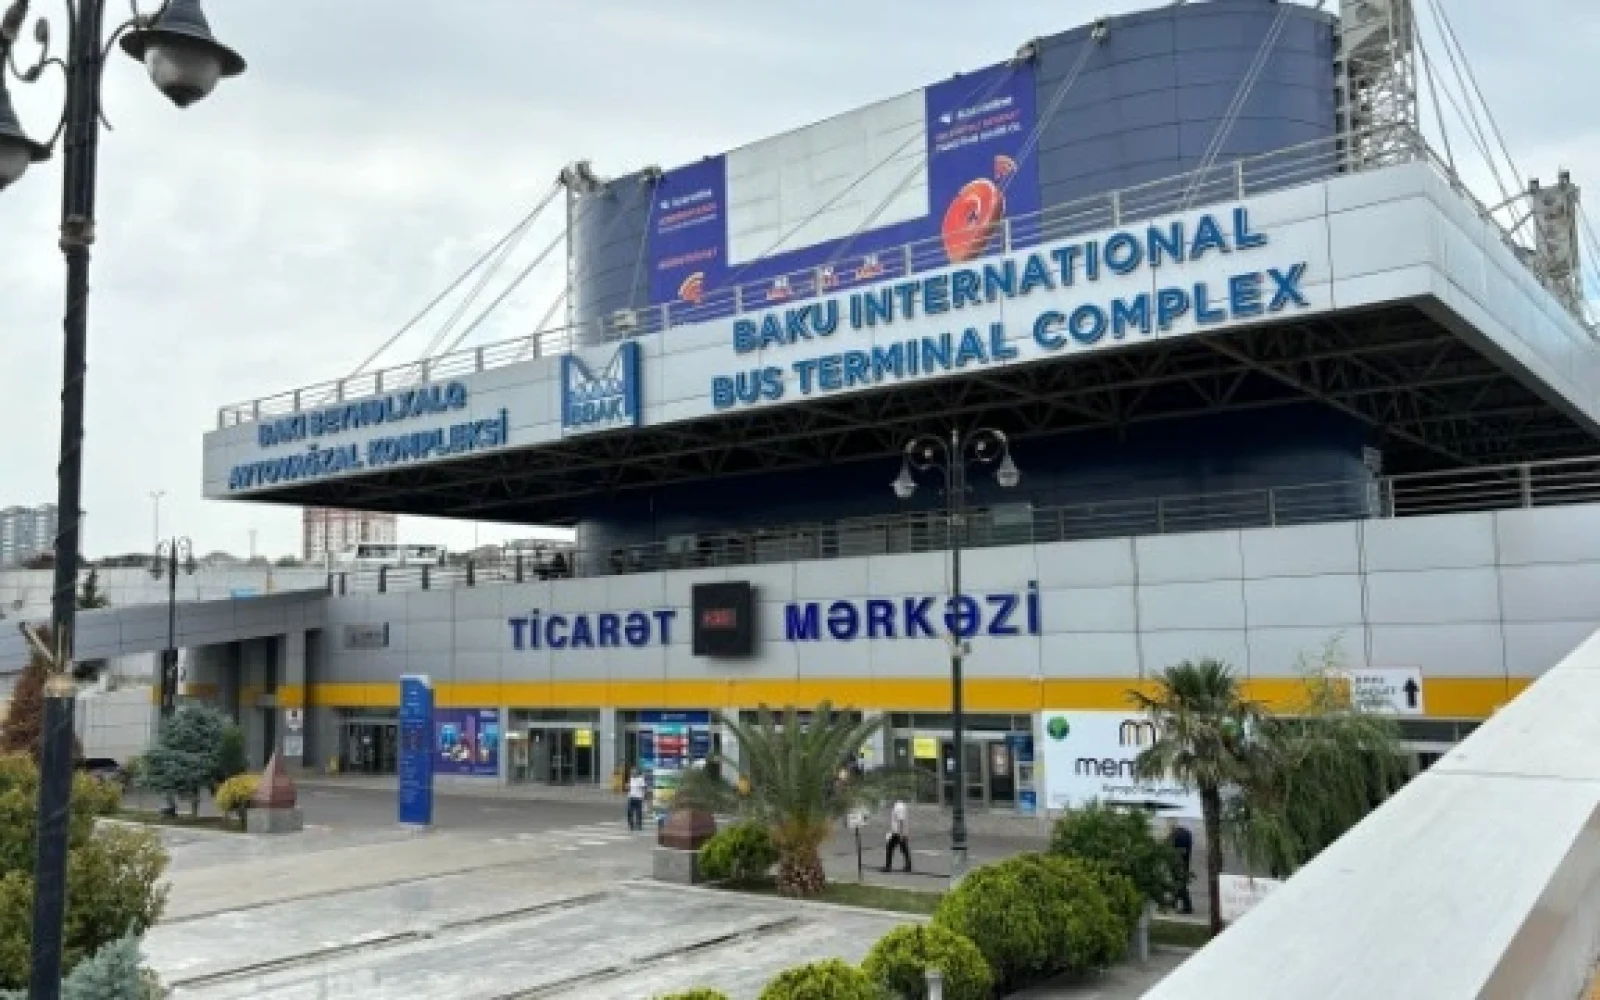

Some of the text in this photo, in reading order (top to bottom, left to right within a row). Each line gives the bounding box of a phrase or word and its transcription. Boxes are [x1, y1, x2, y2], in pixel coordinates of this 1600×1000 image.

[711, 261, 1311, 410] BUS TERMINAL COMPLEX
[733, 206, 1268, 356] BAKU INTERNATIONAL
[508, 580, 1042, 651] TİCARƏT MƏRKƏZİ
